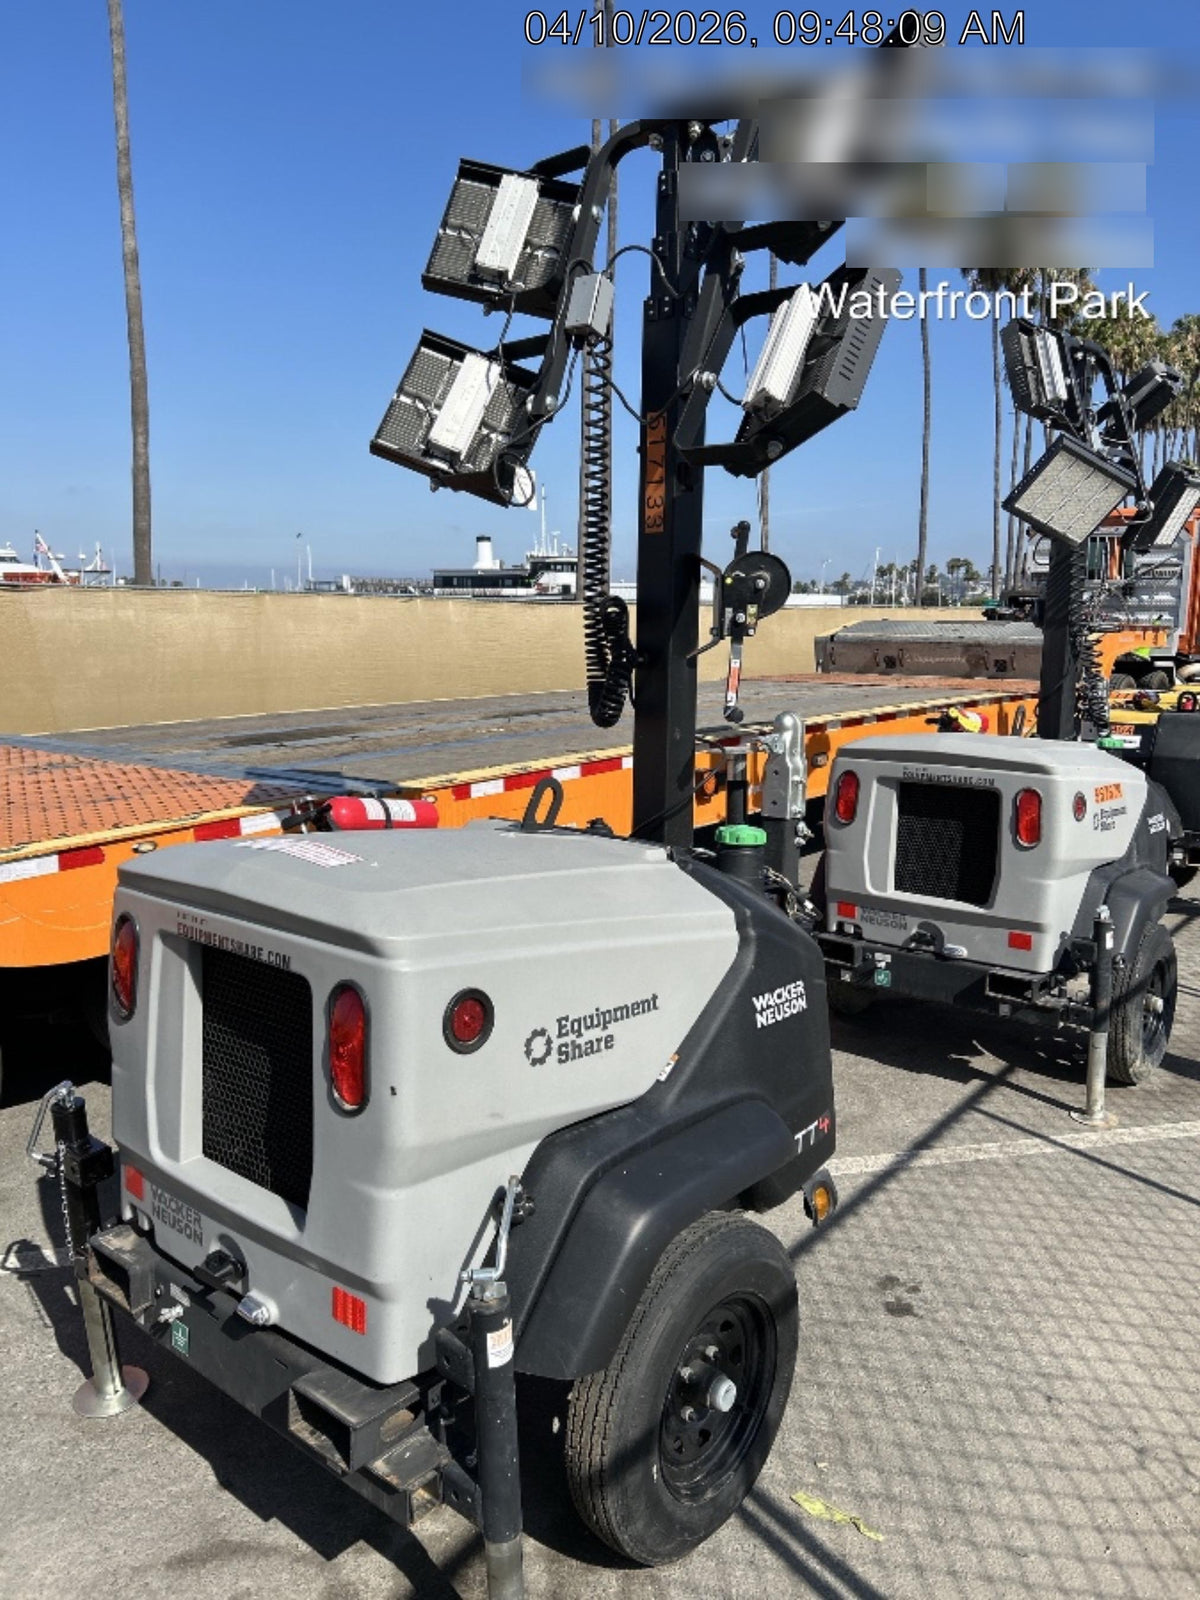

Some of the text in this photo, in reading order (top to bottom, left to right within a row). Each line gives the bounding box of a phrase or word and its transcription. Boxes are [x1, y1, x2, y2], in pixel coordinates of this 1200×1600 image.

[752, 979, 806, 1012] WACKER
[755, 995, 808, 1029] NEUSON
[556, 993, 659, 1039] Equipment
[557, 1034, 615, 1065] Share
[794, 1116, 830, 1154] TT4
[152, 1201, 203, 1247] NEUSON
